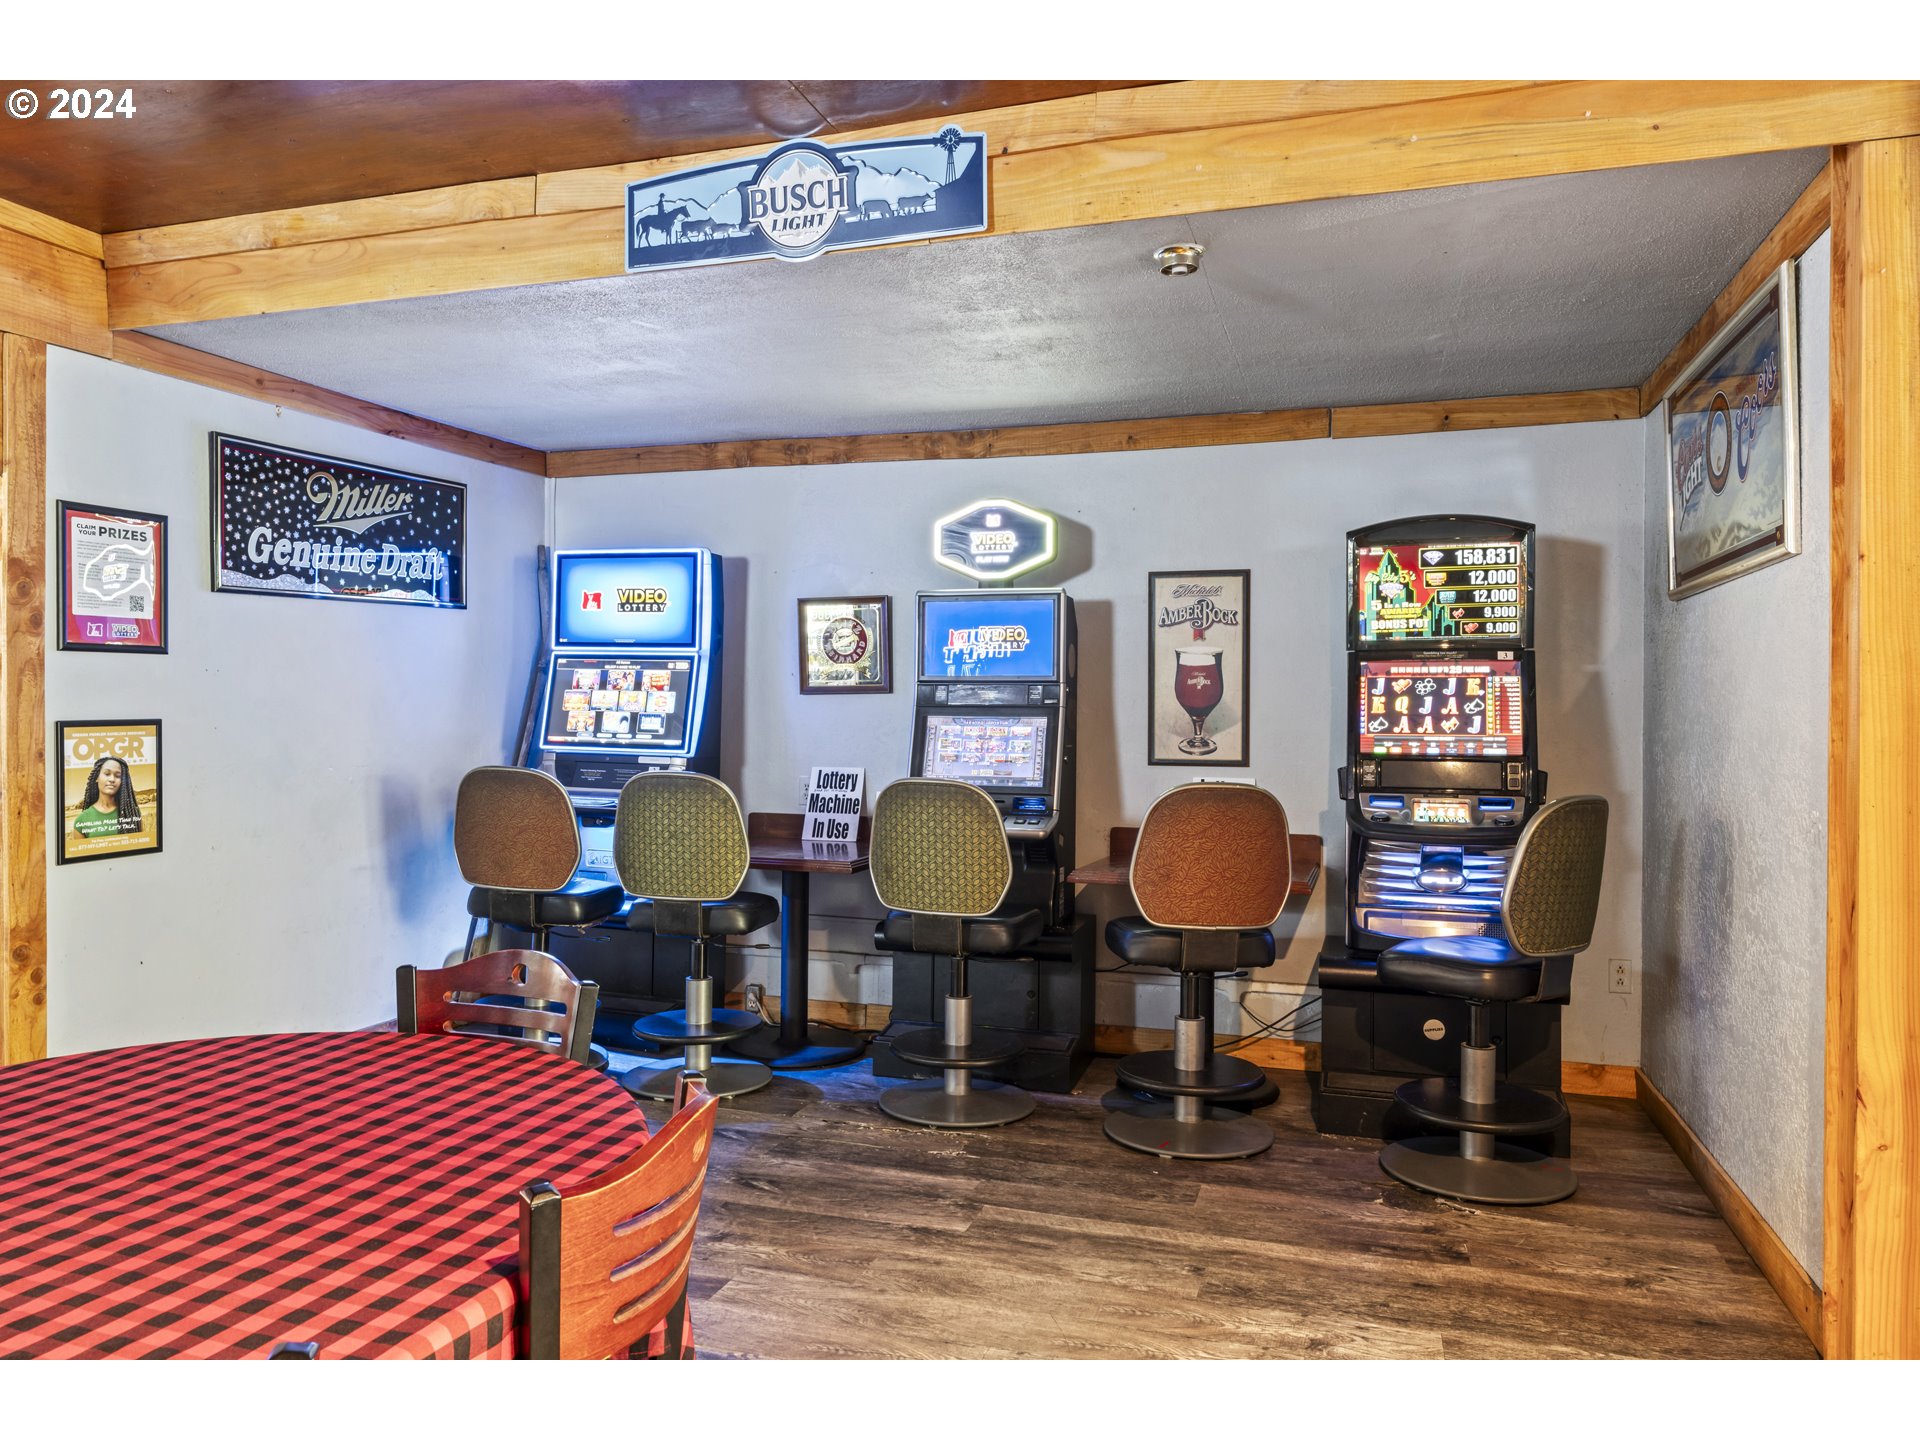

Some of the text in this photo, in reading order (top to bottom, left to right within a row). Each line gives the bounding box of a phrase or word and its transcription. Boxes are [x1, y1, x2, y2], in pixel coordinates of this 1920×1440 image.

[750, 178, 846, 220] BUSCH
[771, 213, 828, 233] LIGHT
[306, 471, 413, 522] Miller
[98, 526, 148, 542] PRIZES
[972, 533, 1014, 545] VIDEO
[247, 525, 445, 580] Genuine Draft
[1455, 547, 1517, 566] 158,831
[1468, 569, 1517, 586] 12,000
[616, 588, 668, 604] VIDEO
[1472, 588, 1517, 604] 12,000
[616, 603, 668, 613] LOTTERY
[1484, 606, 1517, 619] 9,900
[1370, 619, 1408, 630] BONUS
[1486, 622, 1517, 634] 9,000
[1371, 677, 1386, 695] J
[1442, 677, 1457, 695] J
[1394, 696, 1409, 714] Q
[1418, 696, 1433, 714] J
[1441, 696, 1459, 715] A
[1393, 715, 1482, 734] A A J
[72, 735, 145, 762] OPGR
[816, 769, 858, 792] Lottery
[808, 793, 860, 815] Machine
[811, 817, 850, 839] In Use
